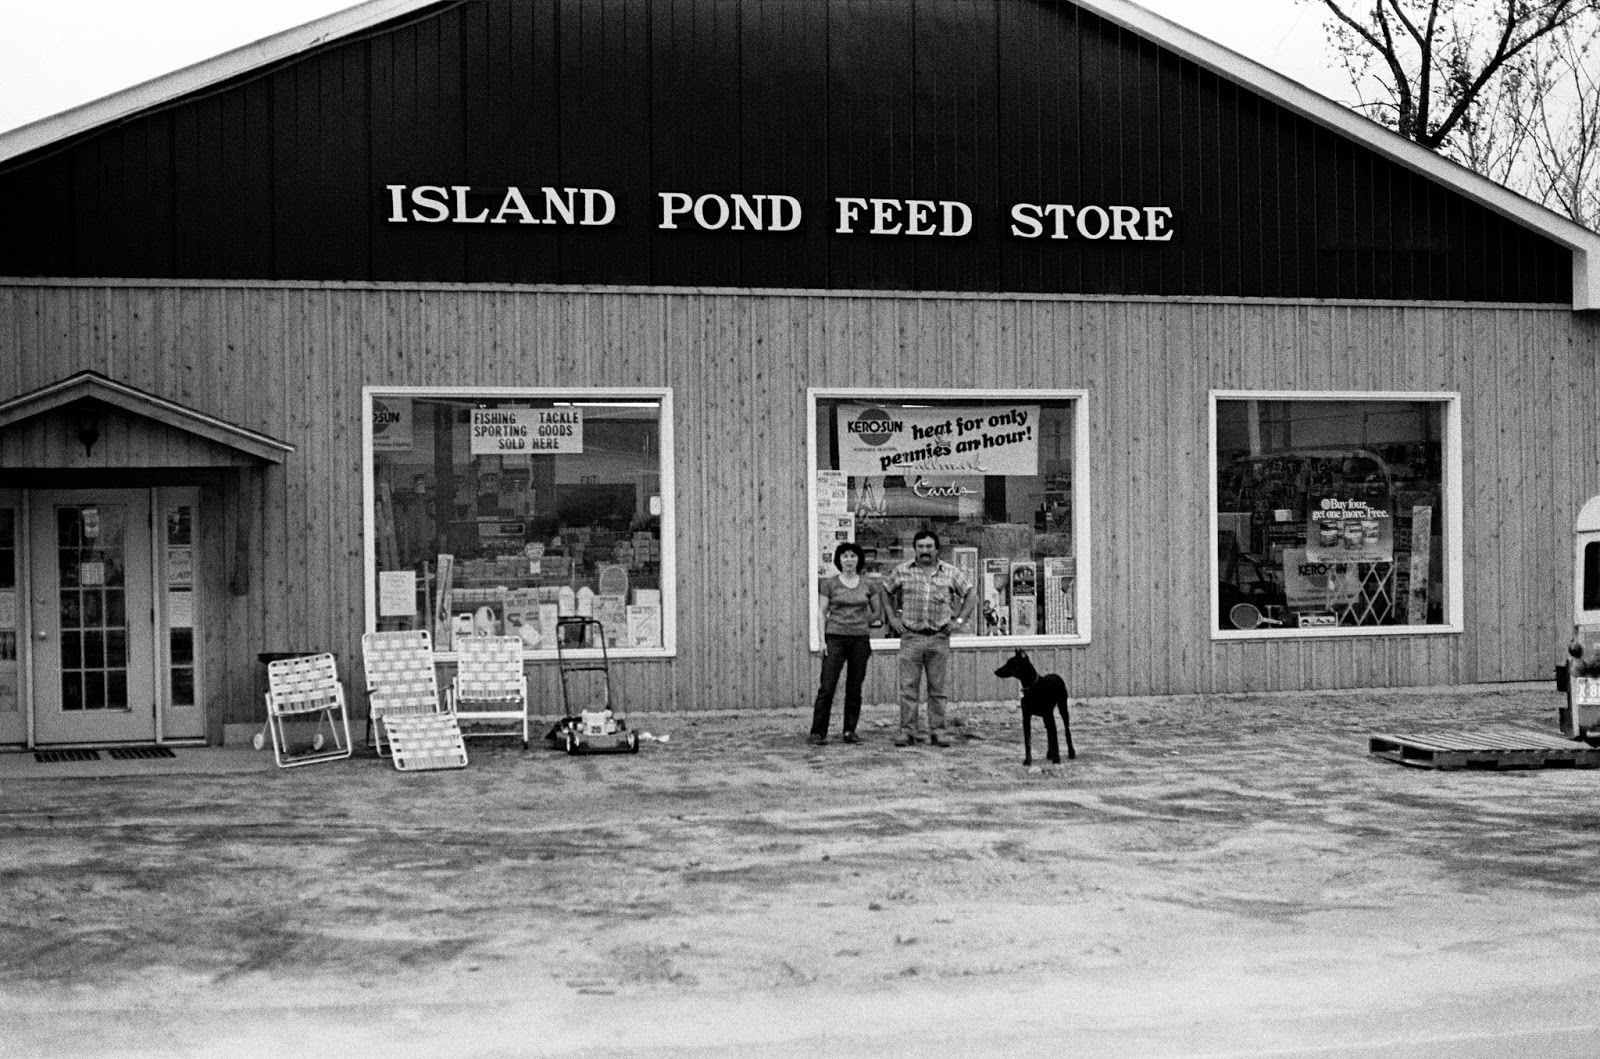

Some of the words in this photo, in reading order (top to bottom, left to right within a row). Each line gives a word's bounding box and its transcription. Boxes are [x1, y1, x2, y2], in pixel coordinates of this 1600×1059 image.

[386, 184, 616, 226] ISLAND
[658, 192, 802, 232] POND
[835, 197, 973, 236] FEED
[1011, 203, 1174, 241] STORE
[474, 412, 517, 425] FISHING
[538, 412, 579, 424] TACKLE
[911, 420, 953, 441] heat
[956, 417, 984, 436] for
[988, 409, 1028, 427] only
[474, 425, 527, 437] SPORTING
[538, 424, 573, 436] GOODS
[498, 438, 525, 450] SOLD
[532, 438, 559, 449] HERE
[879, 443, 952, 471] pennies
[955, 439, 981, 454] an
[981, 425, 1032, 449] hour!
[913, 478, 978, 498] Cards
[1330, 498, 1348, 510] Buy
[1348, 498, 1368, 510] four,
[1312, 510, 1326, 521] get
[1325, 510, 1341, 518] one
[1341, 509, 1366, 518] more.
[1366, 507, 1389, 518] Free.
